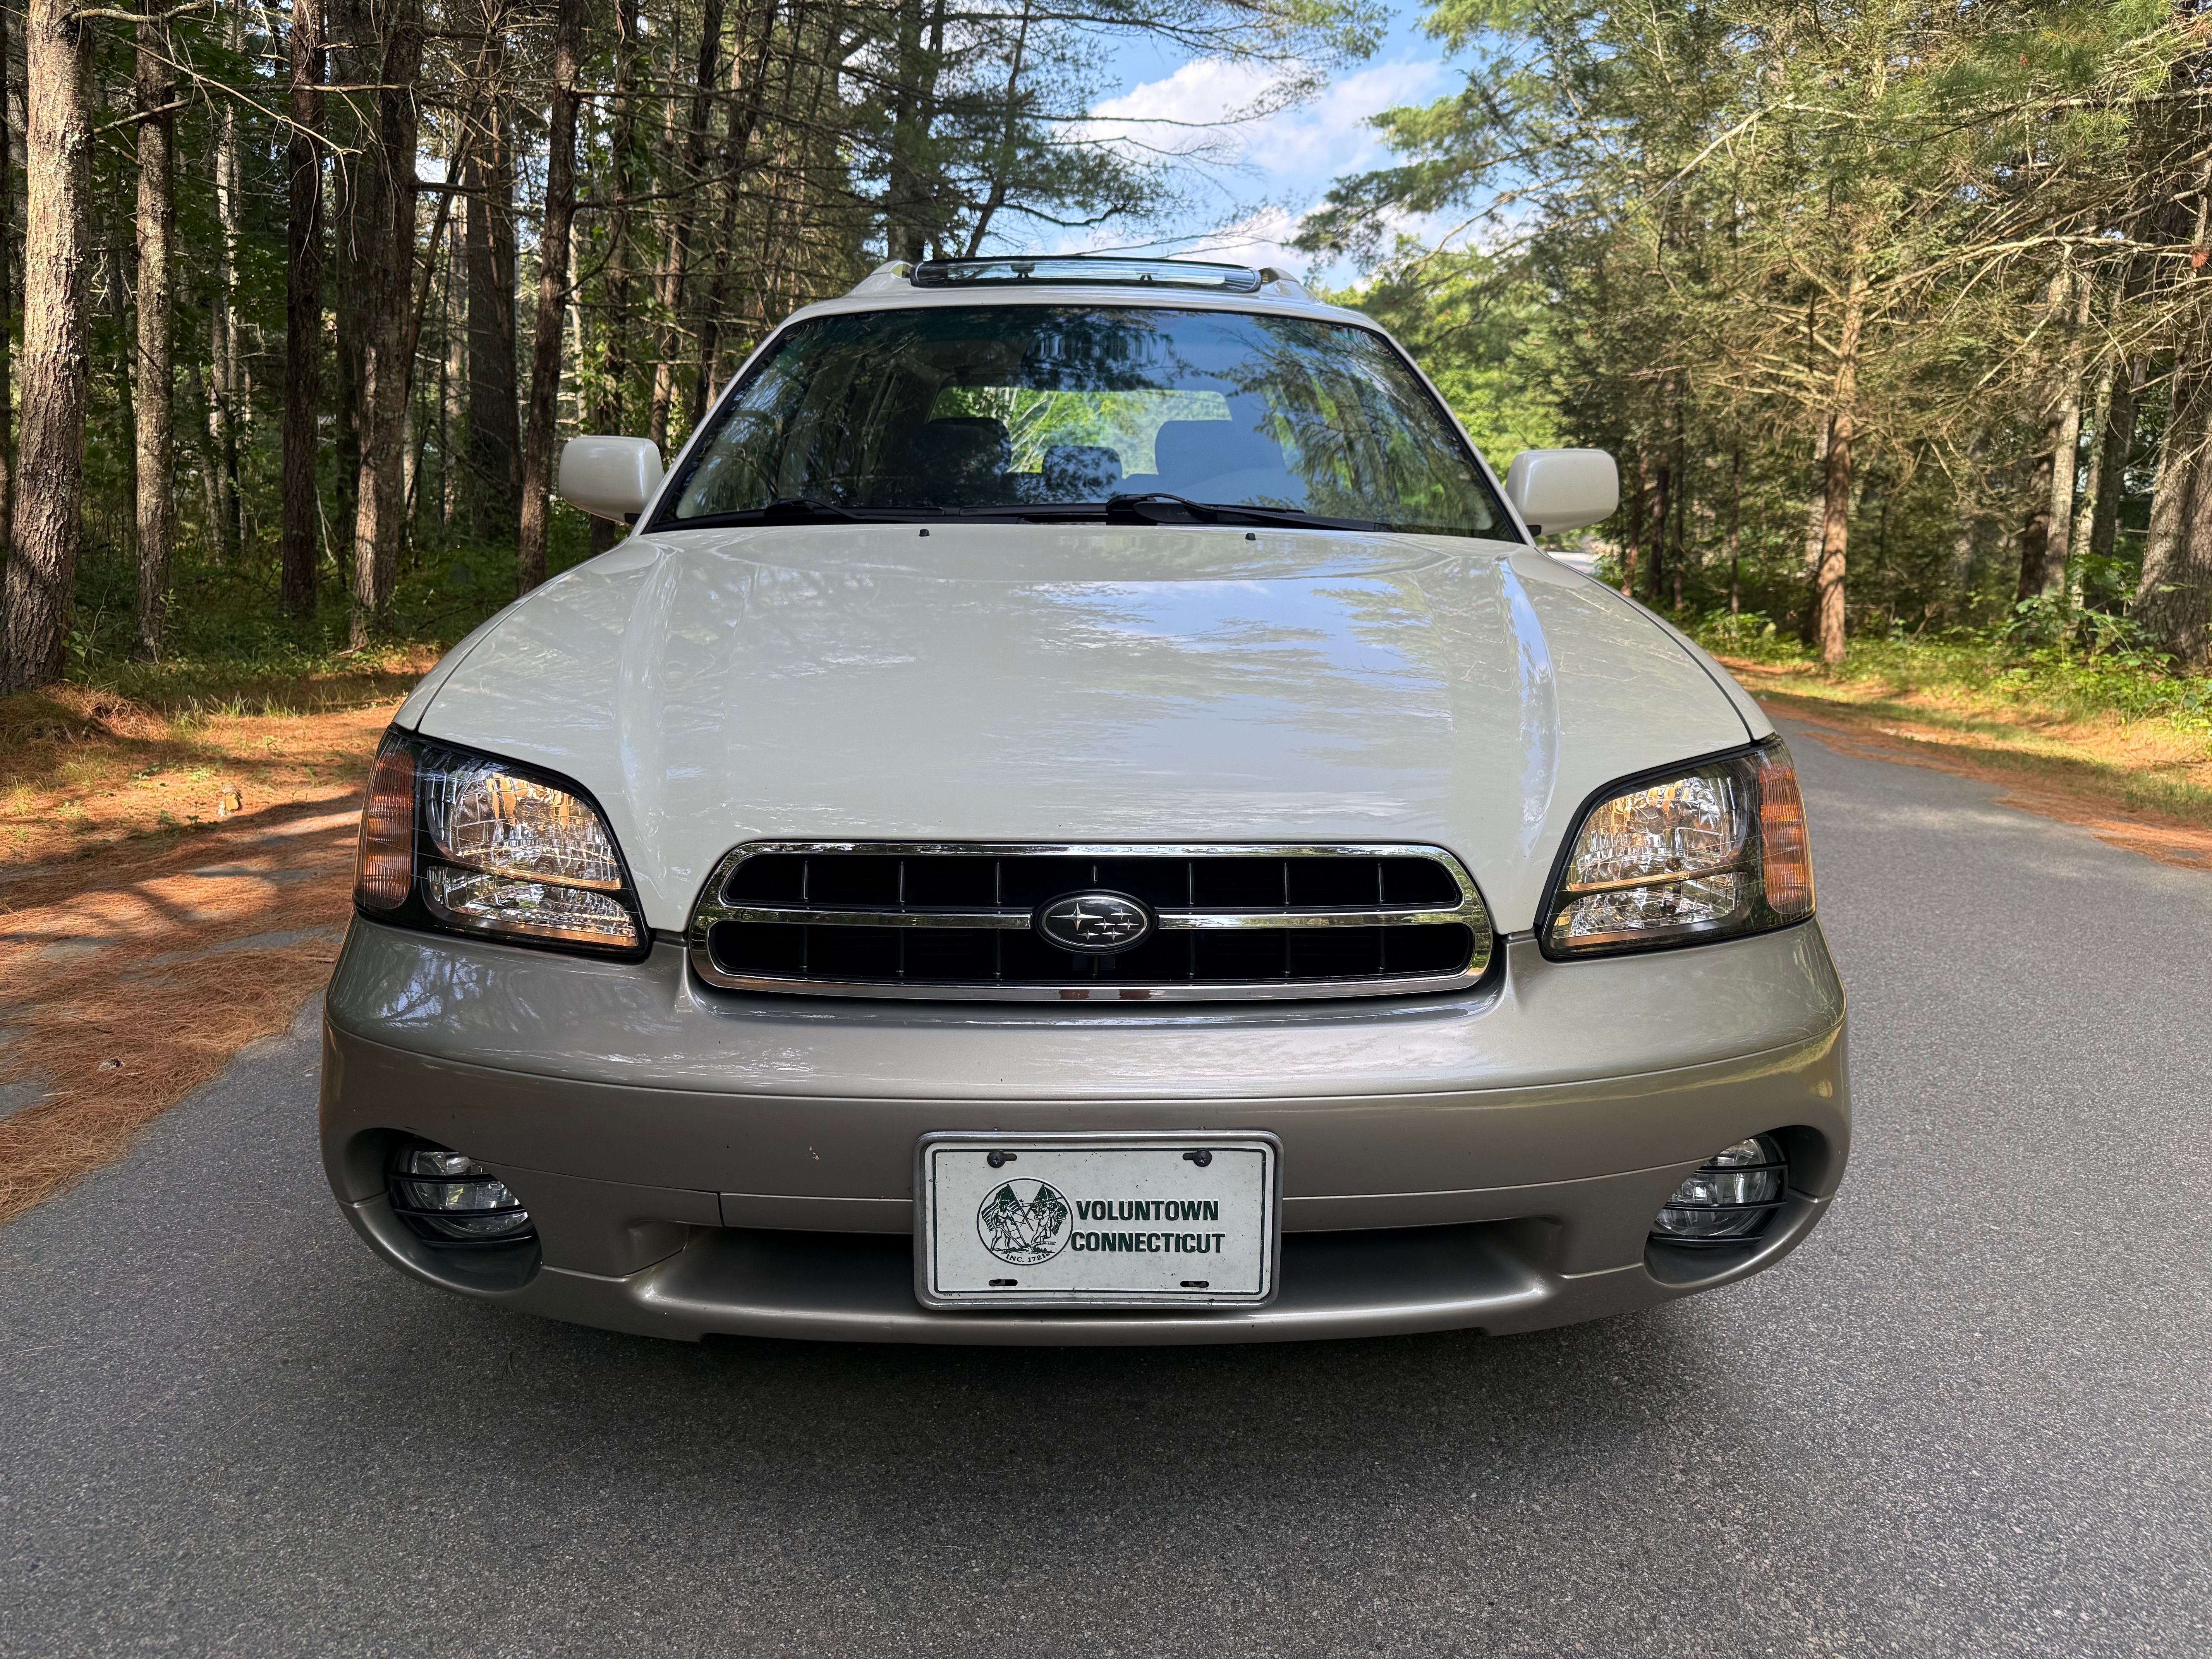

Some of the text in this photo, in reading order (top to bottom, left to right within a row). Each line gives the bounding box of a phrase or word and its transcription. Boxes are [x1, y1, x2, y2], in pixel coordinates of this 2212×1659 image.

[1076, 1200, 1219, 1221] VOLUNTOWN
[1071, 1231, 1225, 1254] CONNECTICUT
[1005, 1254, 1024, 1262] INC.
